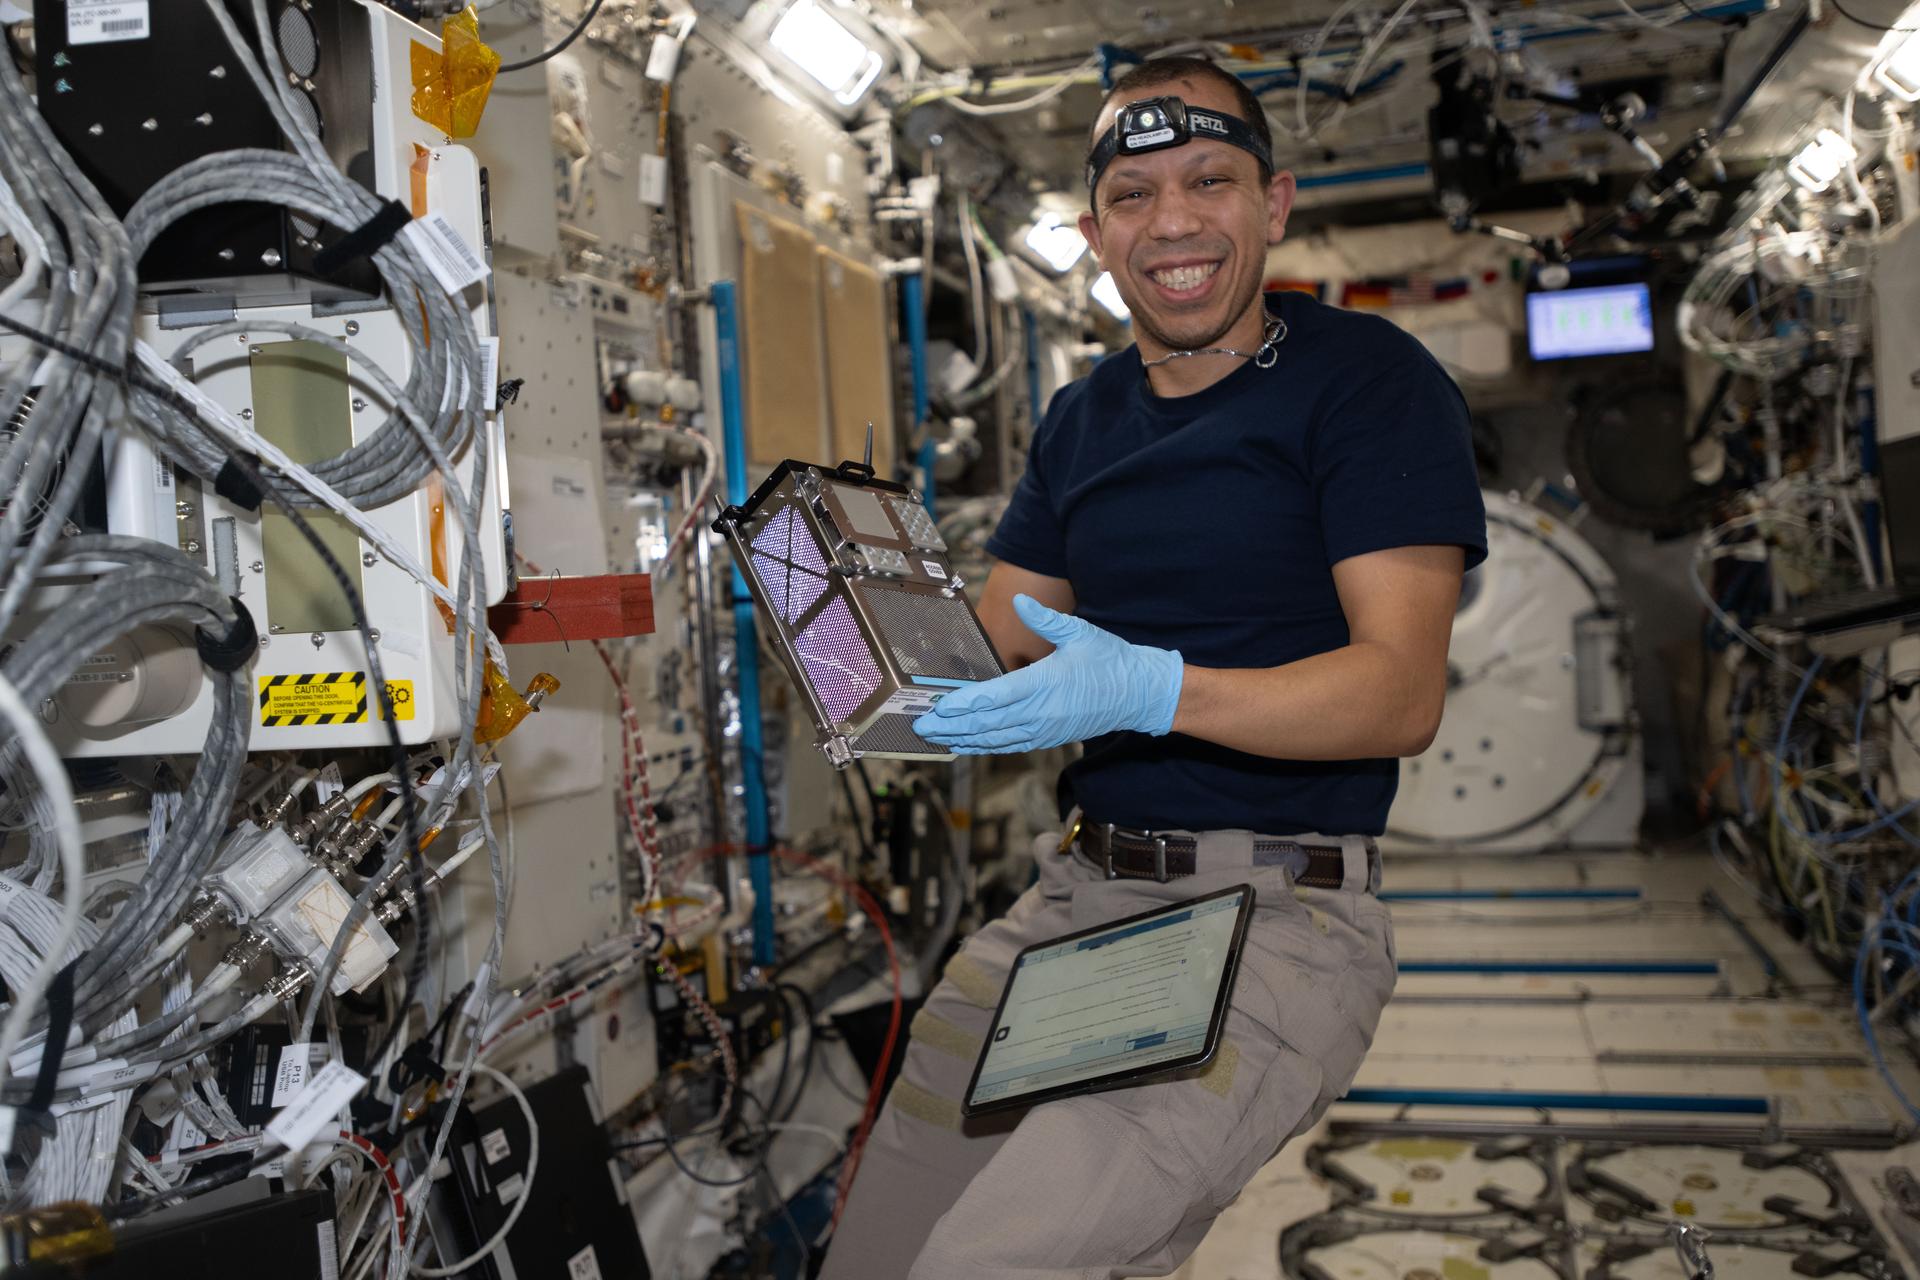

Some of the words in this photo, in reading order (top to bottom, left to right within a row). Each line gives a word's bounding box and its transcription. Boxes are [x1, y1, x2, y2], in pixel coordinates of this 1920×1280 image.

[1189, 113, 1229, 134] PETZL
[295, 685, 330, 694] CAUTION
[287, 1059, 294, 1067] To
[284, 1068, 293, 1092] Laptop
[292, 1065, 301, 1084] P13
